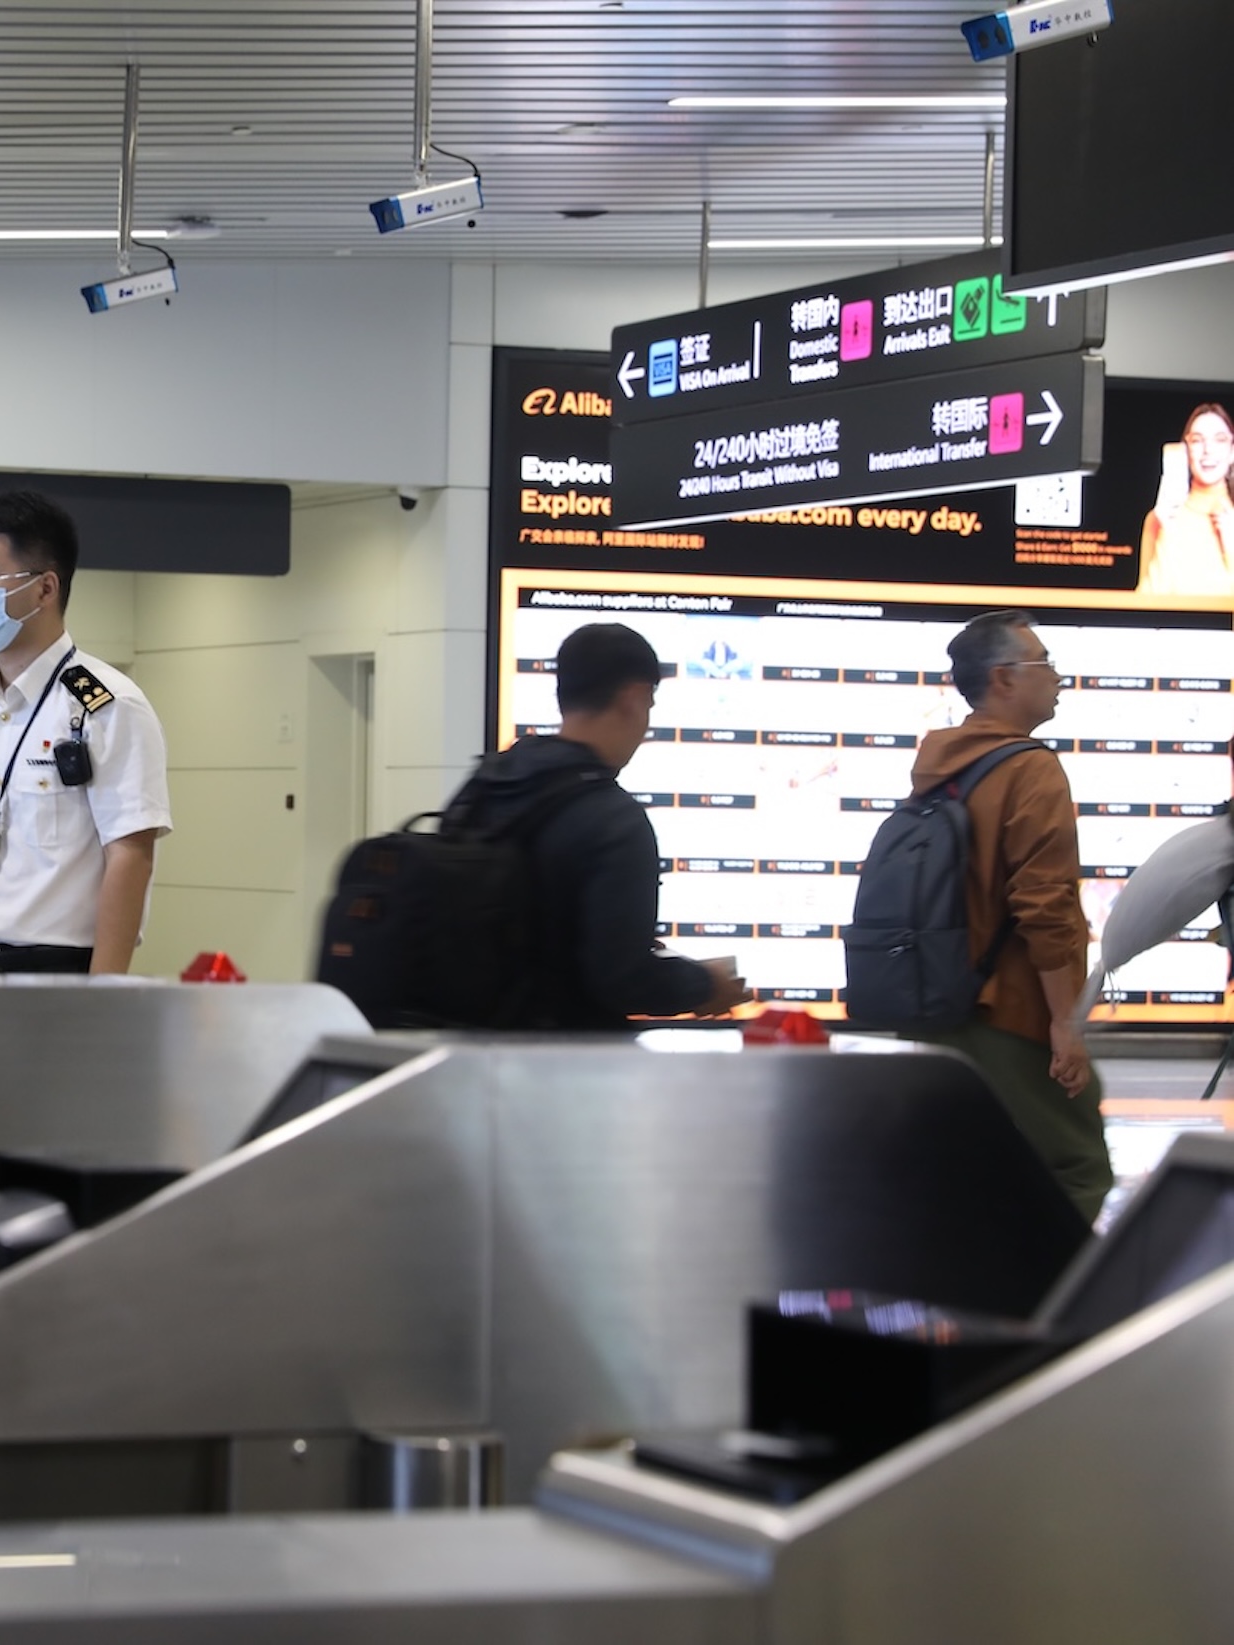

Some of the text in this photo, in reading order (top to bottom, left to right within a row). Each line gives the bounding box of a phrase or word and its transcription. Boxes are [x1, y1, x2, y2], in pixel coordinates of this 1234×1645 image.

[790, 295, 841, 332] 转国内
[883, 286, 953, 326] 到达出口
[679, 334, 711, 367] 签证
[789, 333, 839, 359] Domestic
[883, 324, 951, 355] Arrivals Exit
[679, 361, 751, 391] VISA On Arrival
[932, 397, 988, 436] 转国际
[869, 437, 987, 472] International Transfer
[711, 473, 740, 493] Hours
[740, 468, 773, 488] Transit
[773, 463, 816, 485] Without
[817, 459, 840, 478] Visa
[857, 509, 927, 534] every
[930, 506, 982, 536] day.
